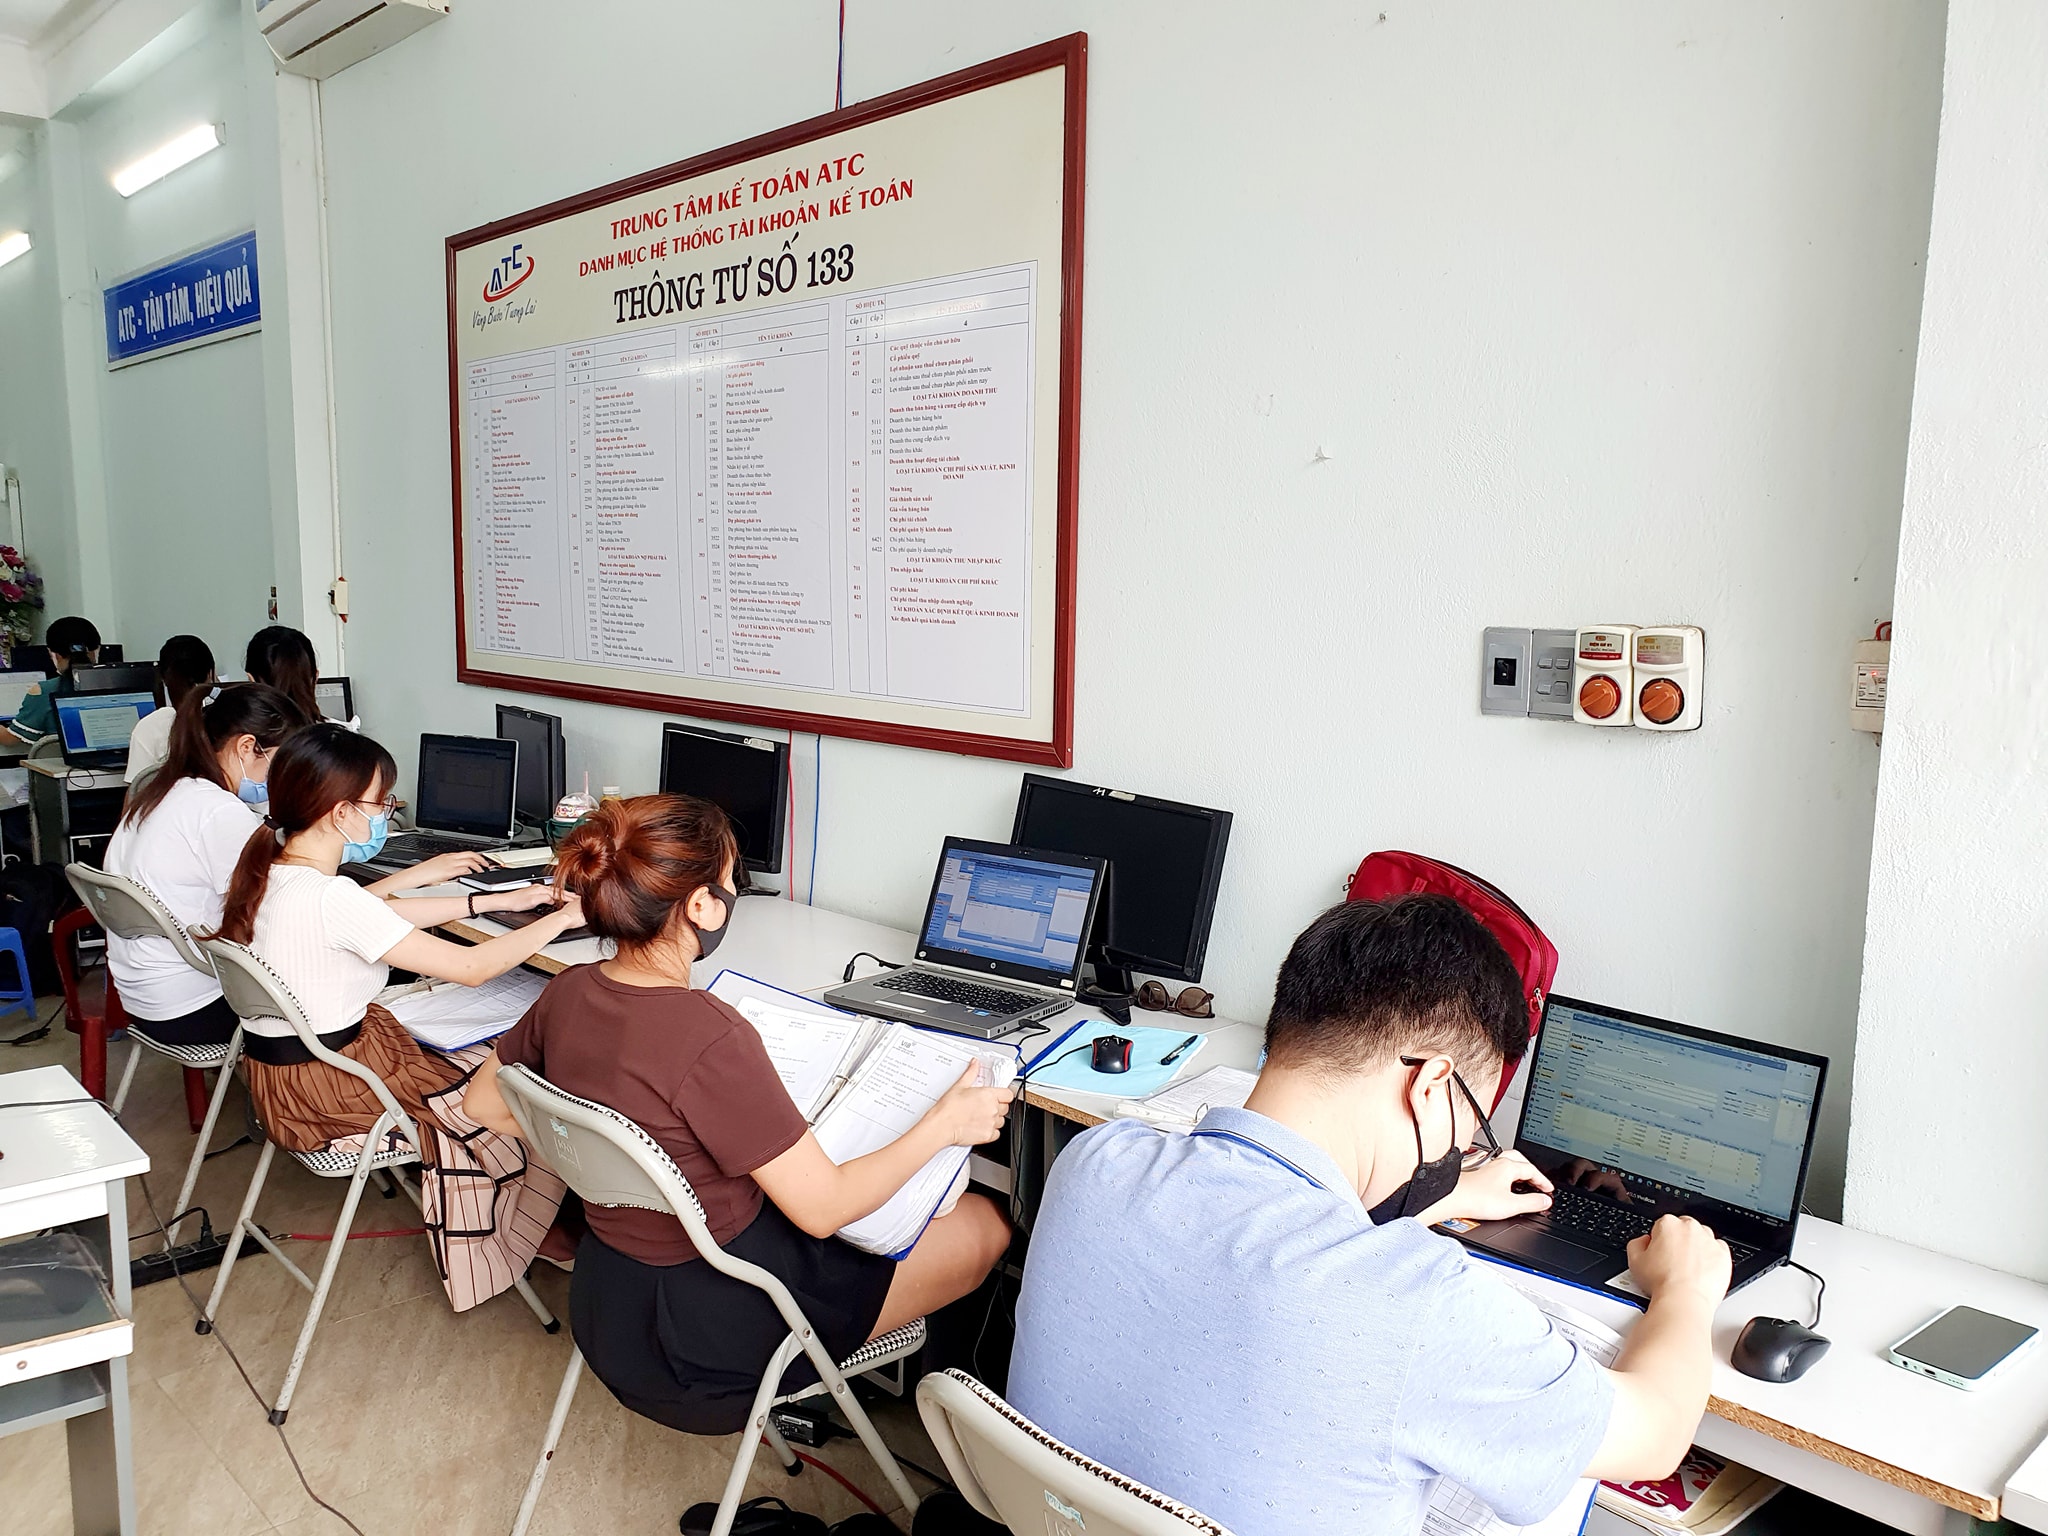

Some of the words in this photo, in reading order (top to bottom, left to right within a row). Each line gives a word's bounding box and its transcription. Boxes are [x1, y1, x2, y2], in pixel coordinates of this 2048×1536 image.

[579, 254, 614, 277] DANH
[617, 246, 647, 269] MỤC
[650, 236, 667, 261] HỆ
[672, 224, 724, 254] THỐNG
[728, 218, 754, 241] TÀI
[758, 200, 819, 234] KHOẢN
[829, 186, 854, 217] KẾ
[858, 177, 913, 210] TOÁN
[610, 208, 668, 240] TRUNG
[673, 194, 713, 223] TÂM
[718, 177, 745, 212] KẾ
[749, 167, 809, 203] TOÁN
[816, 153, 865, 187] ATC
[118, 305, 136, 343] ATC
[143, 291, 165, 340] TẬN
[165, 282, 194, 326] TÂM,
[195, 269, 223, 323] HIỆU
[224, 247, 253, 313] QUẢ
[490, 243, 523, 293] ATC
[524, 298, 538, 316] Lai
[614, 269, 705, 323] THÔNG
[712, 256, 752, 304] TƯ
[757, 231, 799, 297] SỐ
[806, 244, 854, 288] 133
